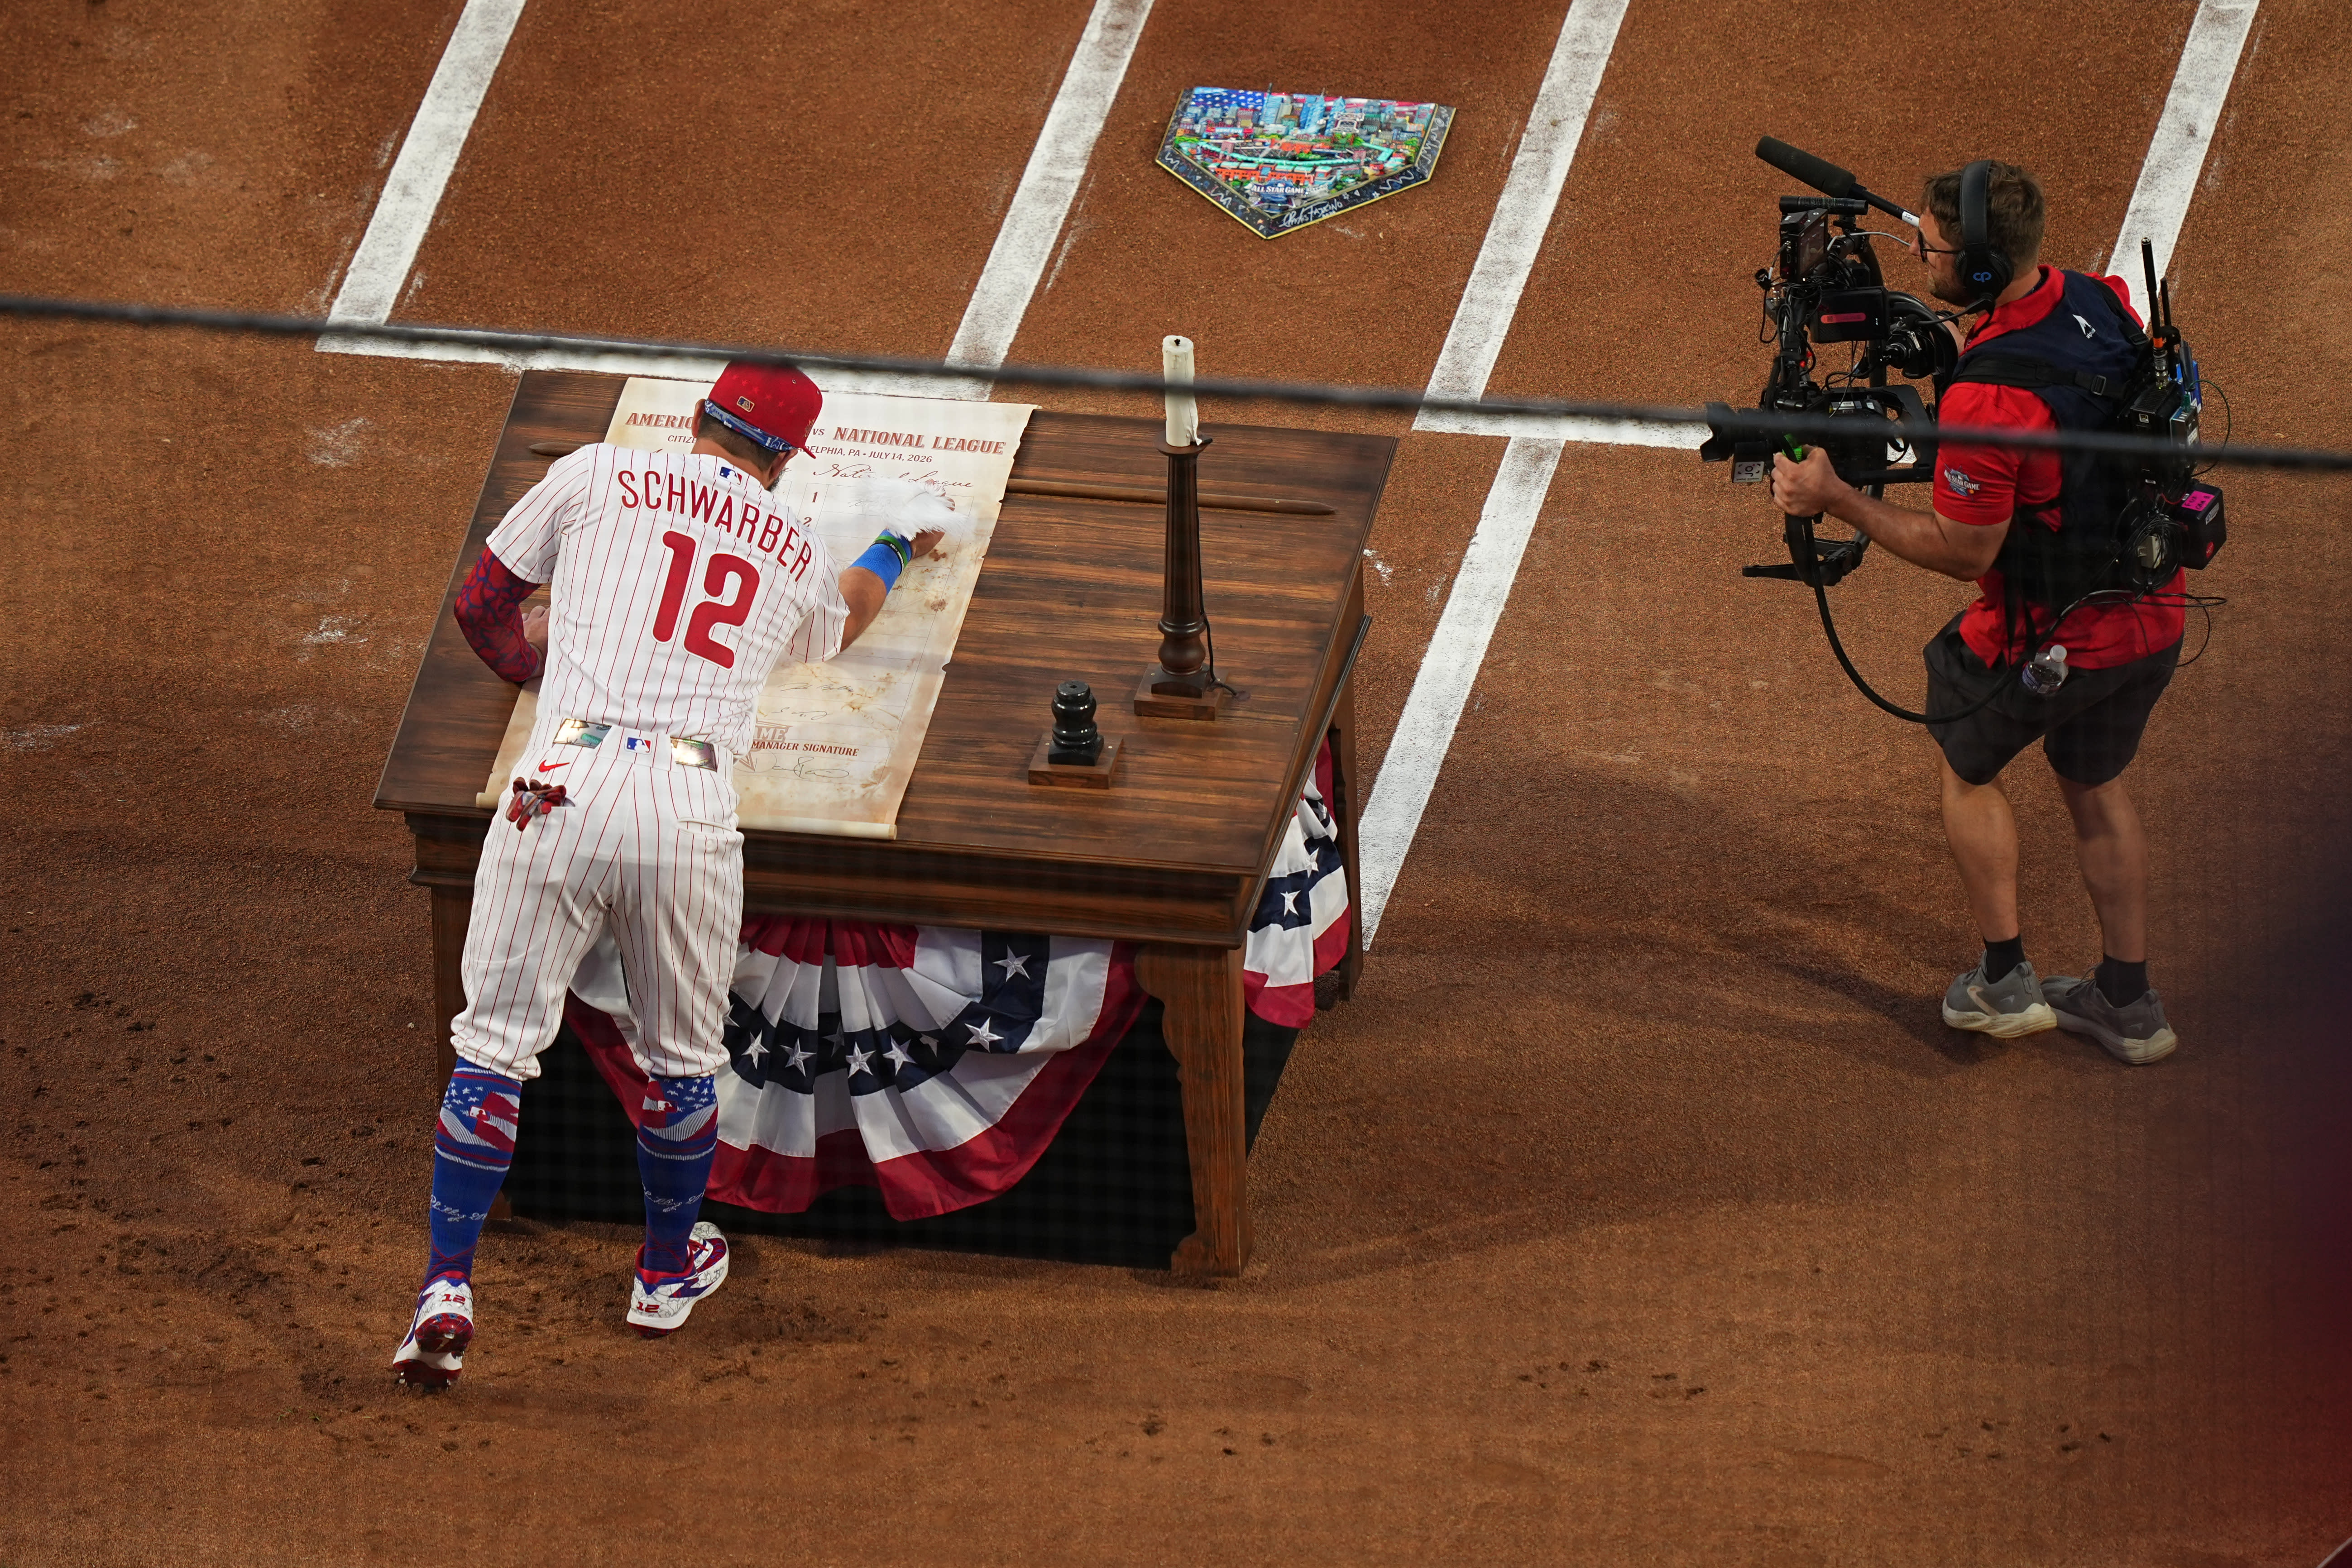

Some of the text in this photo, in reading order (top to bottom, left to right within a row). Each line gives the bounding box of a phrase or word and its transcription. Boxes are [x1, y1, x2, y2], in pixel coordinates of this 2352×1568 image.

[1251, 184, 1265, 192] ALL
[1285, 186, 1305, 195] GAME
[833, 427, 925, 449] NATIONAL
[931, 436, 1006, 455] LEAGUE
[868, 451, 891, 460] JULY
[891, 453, 905, 461] 14,
[907, 454, 933, 463] 2026
[1952, 475, 1964, 487] STAR
[1964, 481, 1980, 490] GAME
[811, 492, 818, 503] 1
[617, 469, 813, 583] SCHWARBER
[803, 516, 812, 527] 2
[652, 530, 761, 670] 12
[752, 741, 860, 757] MANAGER SIGNATURE
[442, 1294, 466, 1305] 12
[636, 1301, 660, 1313] 12
